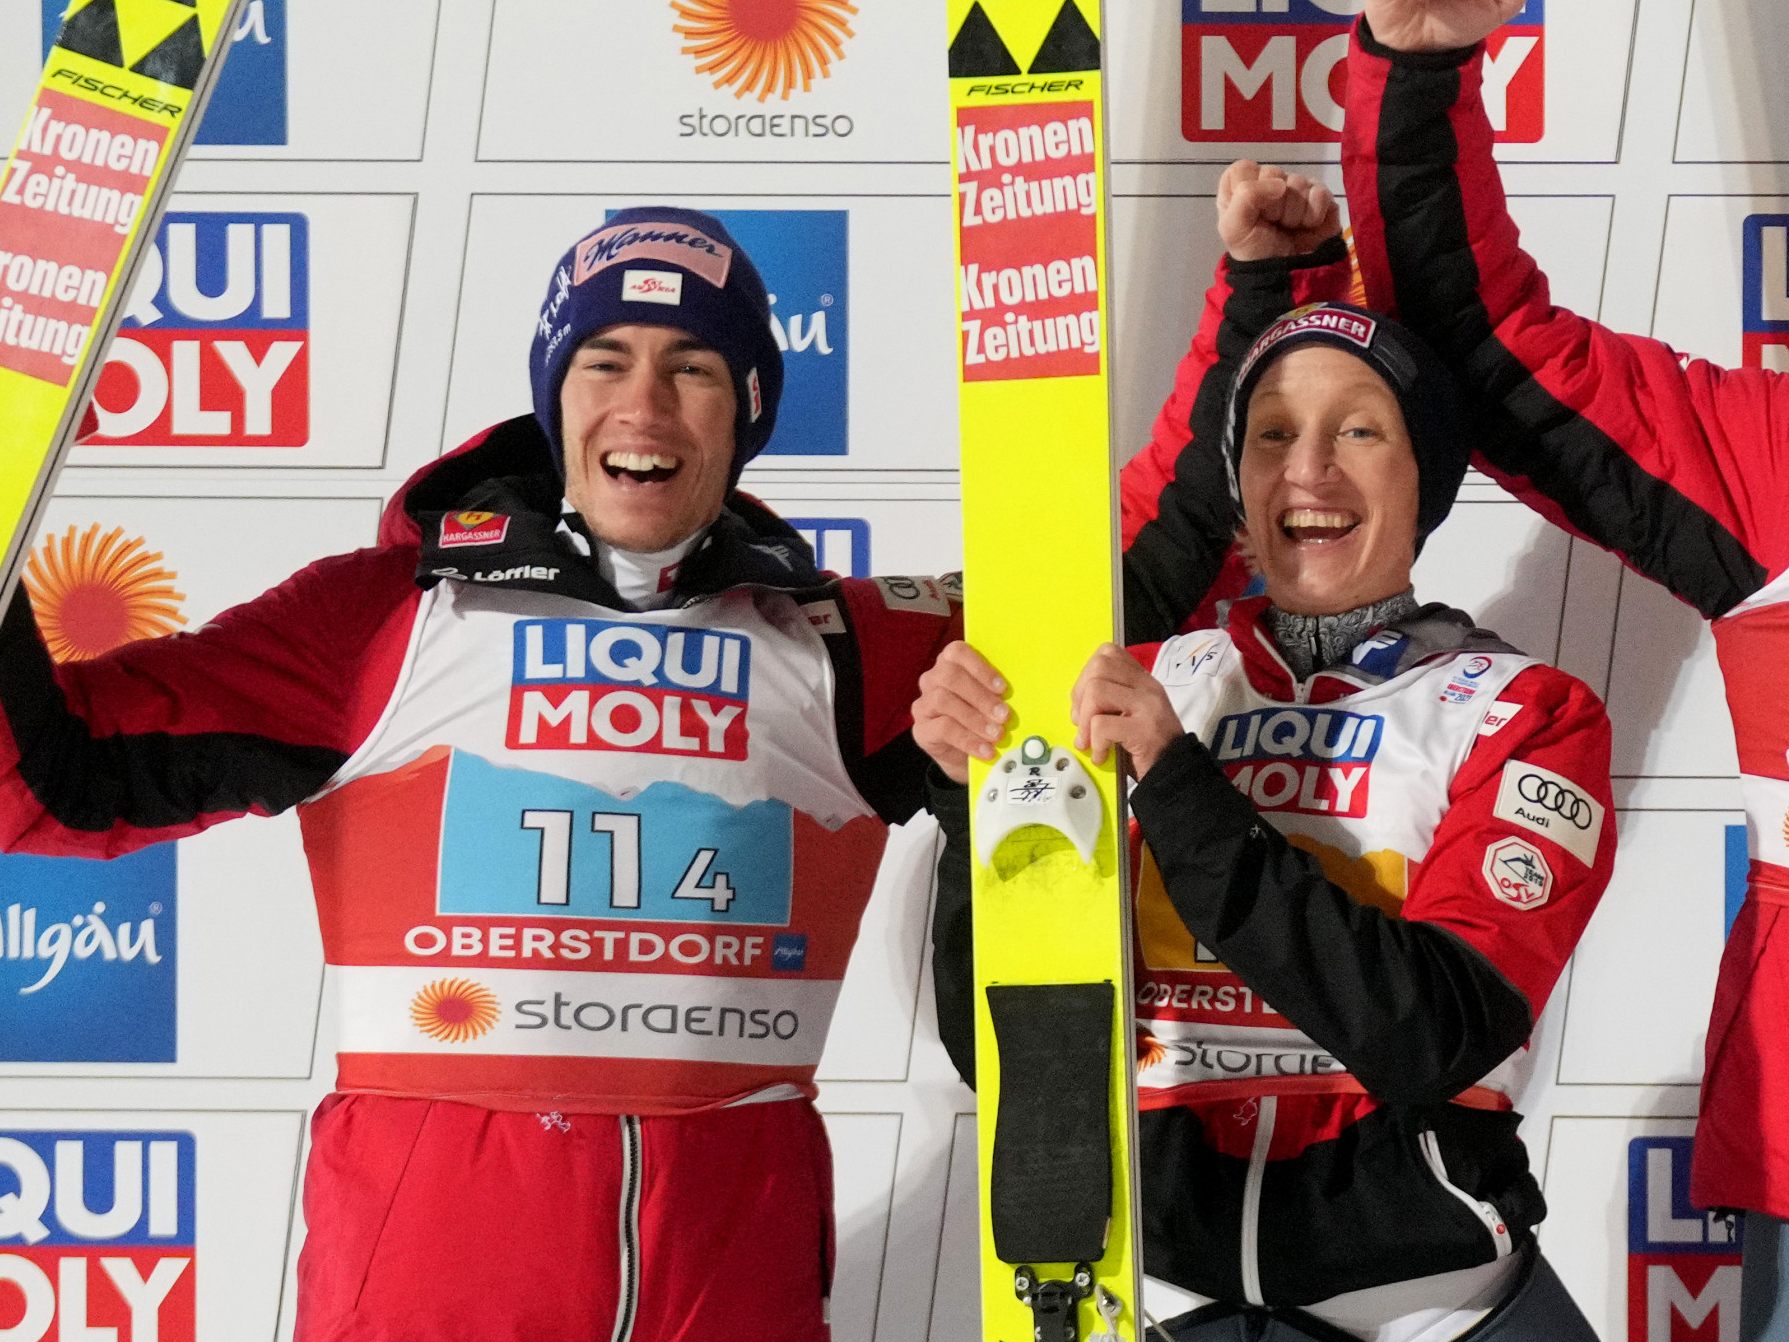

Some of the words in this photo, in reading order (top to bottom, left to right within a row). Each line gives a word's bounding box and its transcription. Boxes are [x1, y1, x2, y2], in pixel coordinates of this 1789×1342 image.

[52, 68, 182, 119] FISCHER
[966, 79, 1084, 97] FISCHER
[20, 106, 161, 177] Kronen
[957, 116, 1095, 174] Kronen
[3, 160, 145, 235] Zeitung
[960, 171, 1097, 227] Zeitung
[583, 227, 723, 272] Manner
[0, 252, 108, 307] ronen
[960, 254, 1098, 312] Kronen
[962, 310, 1099, 365] Zeitung
[92, 339, 304, 426] OLY
[525, 624, 739, 694] LIQUI
[519, 690, 743, 755] MOLY
[1218, 710, 1378, 760] LIQUI
[1514, 807, 1550, 828] Audi
[522, 809, 643, 910] 11
[671, 847, 736, 913] 4
[404, 925, 765, 966] OBERSTDORF
